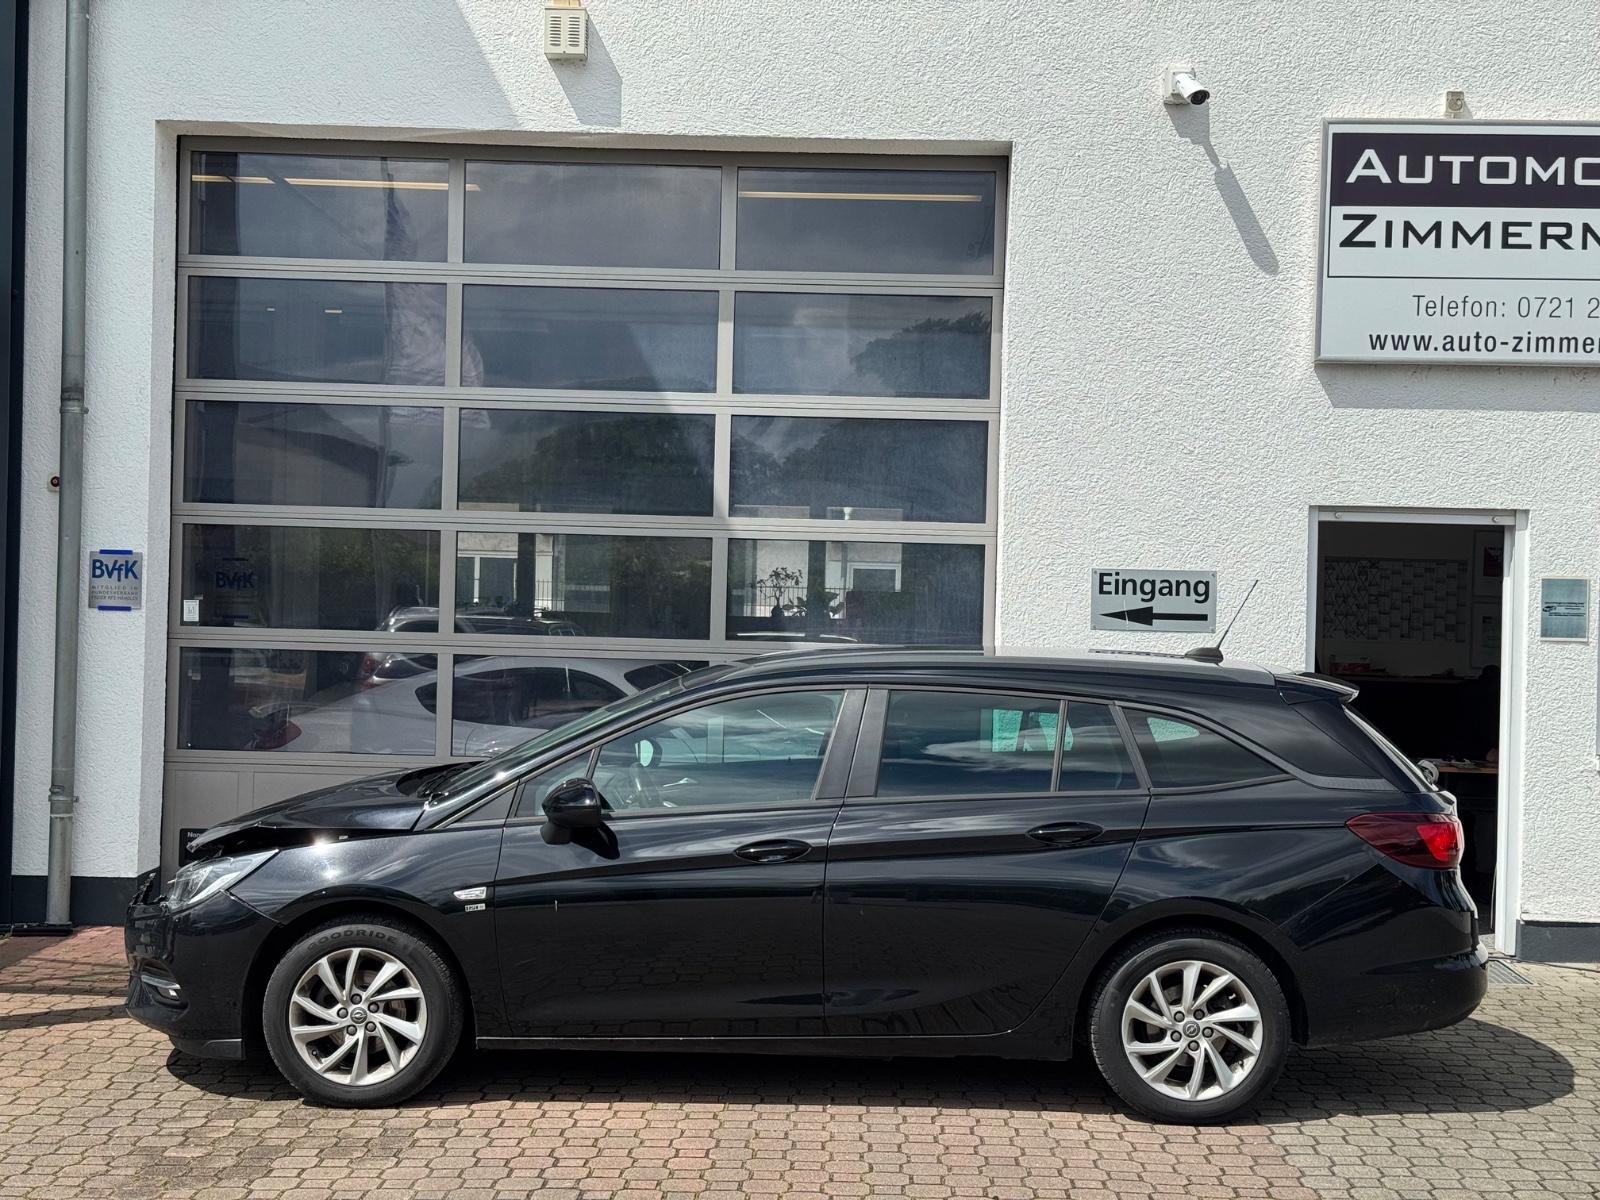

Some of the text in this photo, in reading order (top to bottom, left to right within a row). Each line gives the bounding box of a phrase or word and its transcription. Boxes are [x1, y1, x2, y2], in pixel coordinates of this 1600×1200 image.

[1413, 295, 1506, 318] Telefon:
[1518, 297, 1573, 318] 0721
[1369, 332, 1600, 354] www.auto-zimme
[1099, 572, 1210, 604] Eingang
